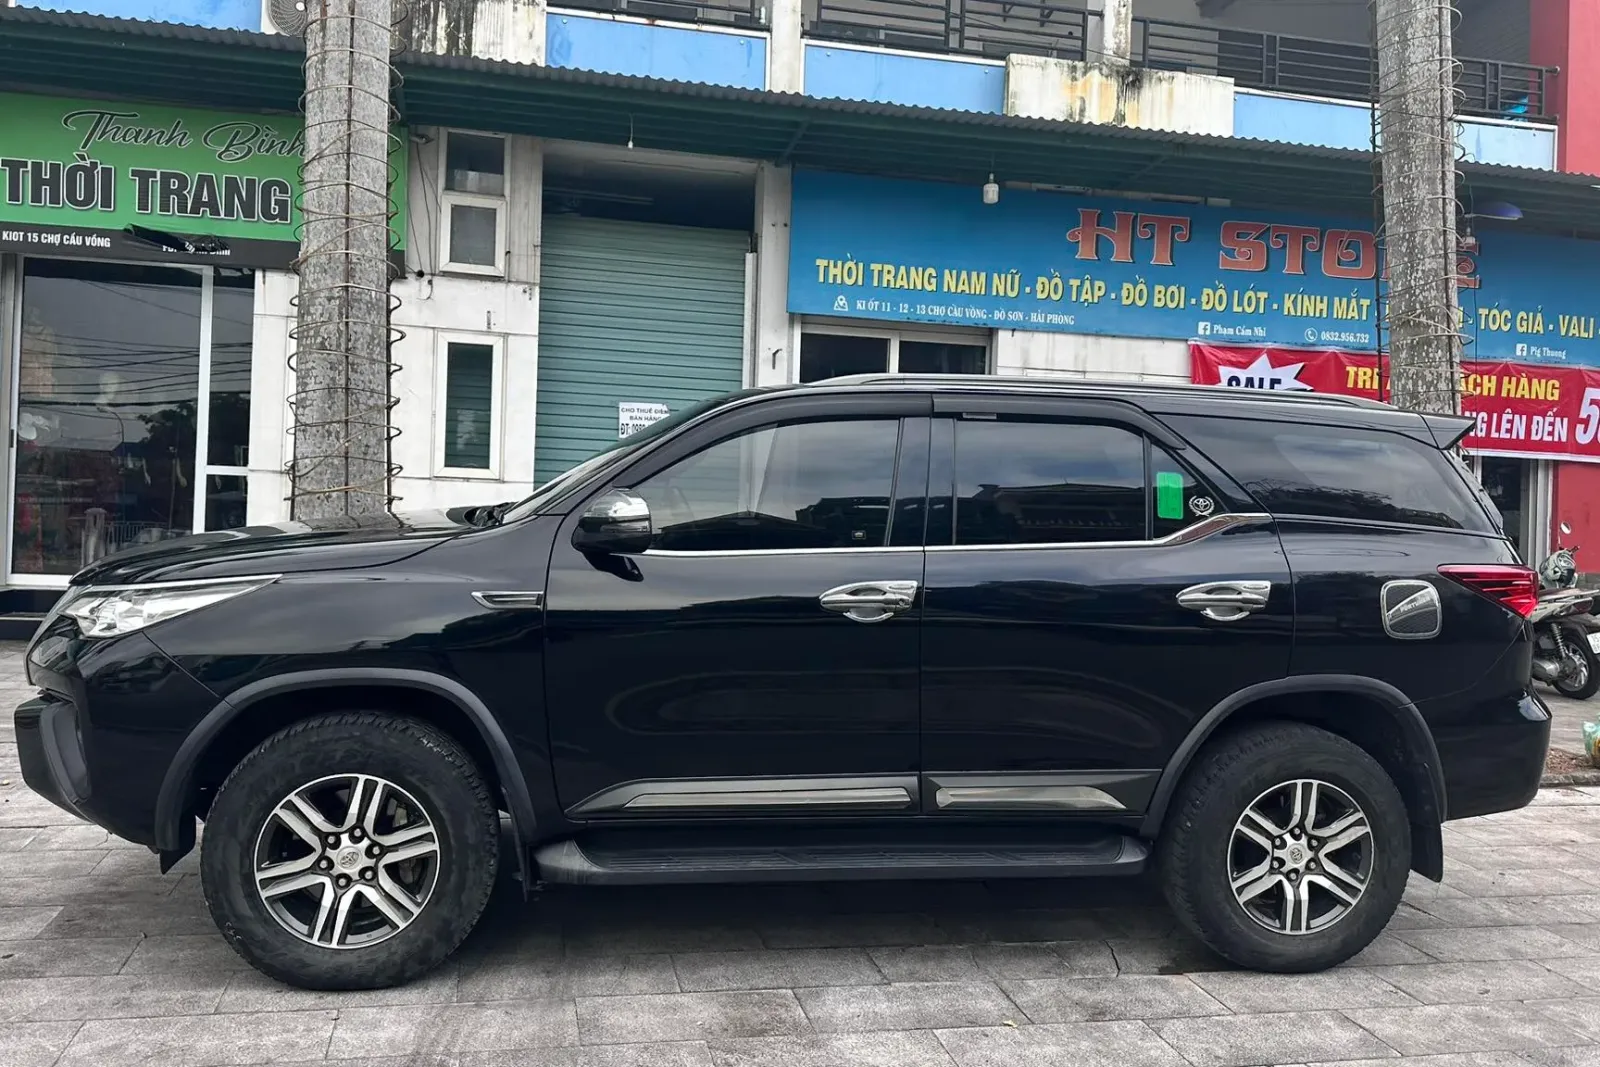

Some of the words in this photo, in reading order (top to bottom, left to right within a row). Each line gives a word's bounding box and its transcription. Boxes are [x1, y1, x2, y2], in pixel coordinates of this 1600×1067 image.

[61, 109, 193, 150] Thanh
[0, 152, 116, 212] THỜI
[129, 167, 292, 223] TRANG
[2, 230, 25, 242] KIOT
[27, 232, 39, 243] 15
[40, 232, 61, 246] CHỢ
[1066, 208, 1190, 266] HT
[1219, 220, 1480, 289] STOE
[816, 252, 864, 286] THỜI
[870, 263, 937, 292] TRANG
[943, 268, 986, 295] NAM
[992, 268, 1021, 298] NỮ
[1035, 268, 1064, 301] ĐỒ
[1069, 274, 1106, 307] TẬP
[1121, 275, 1148, 307] ĐỒ
[1153, 283, 1186, 309] BƠI
[1201, 280, 1228, 312] ĐỒ
[1233, 282, 1269, 314] LÓT
[1283, 287, 1328, 318] KÍNH
[1333, 288, 1370, 321] MẮT
[1478, 302, 1512, 332] TÓC
[1558, 314, 1595, 339] VALI
[856, 300, 866, 310] KI
[881, 302, 891, 312] 11
[899, 303, 909, 313] 12
[916, 304, 926, 315] 13
[928, 305, 946, 316] CHỢ
[1007, 309, 1024, 321] SƠN
[1046, 311, 1075, 325] PHÒNG
[1501, 373, 1560, 400] HÀNG
[1490, 408, 1527, 440] LÊN
[1530, 407, 1568, 442] ĐẾN
[1575, 387, 1600, 445] 5
